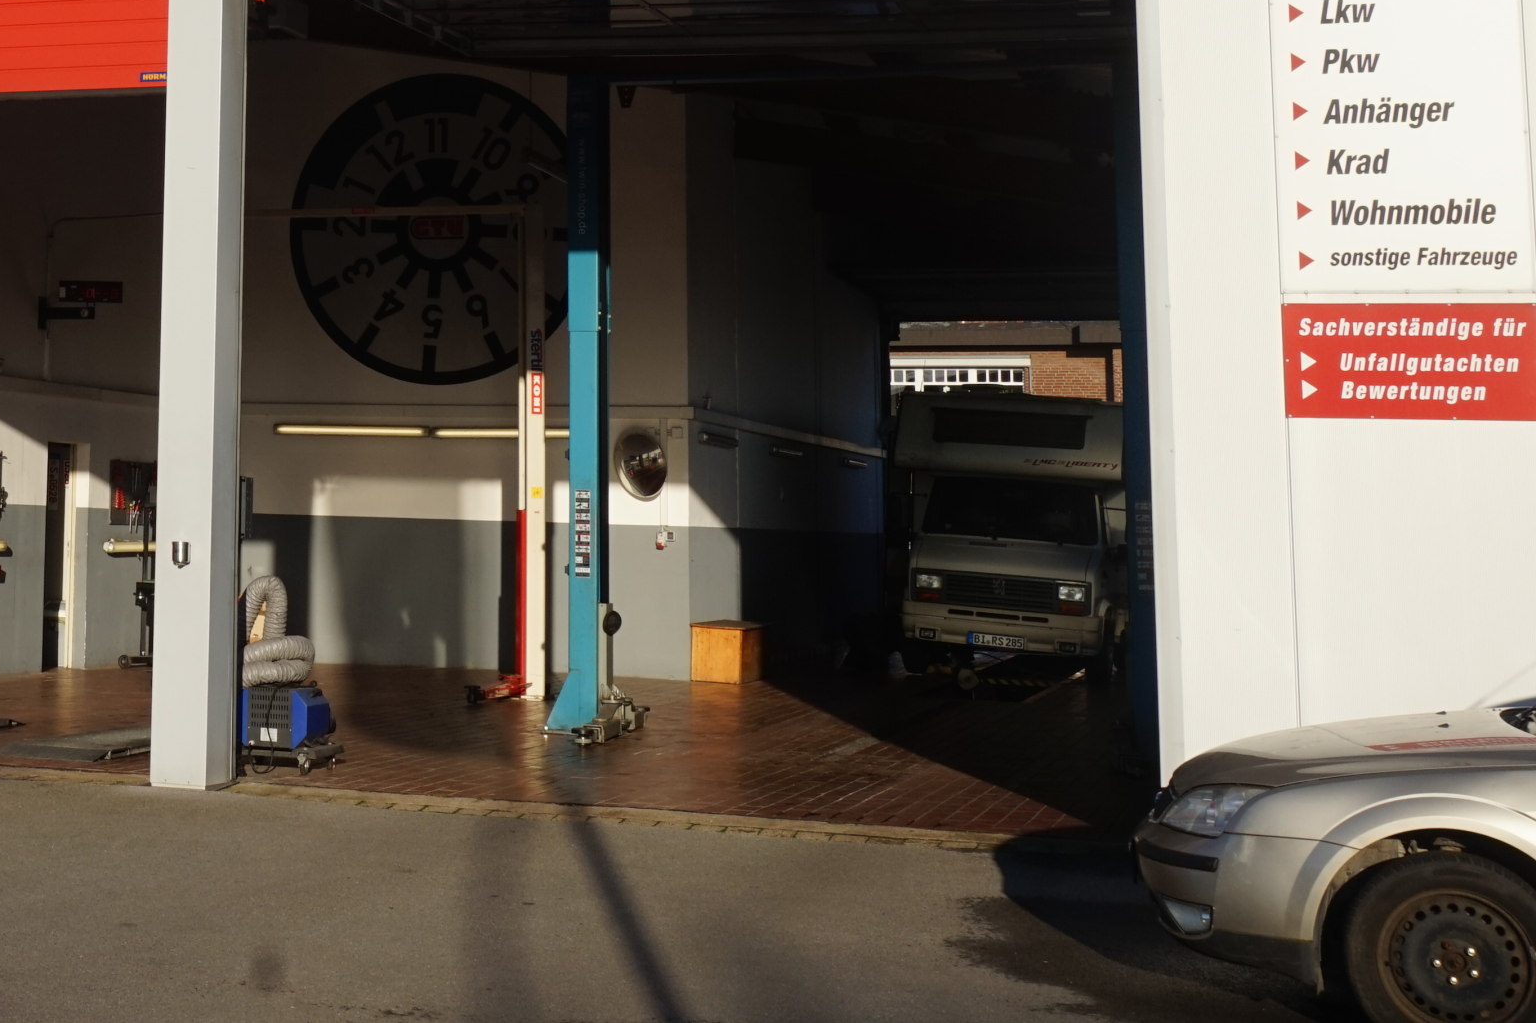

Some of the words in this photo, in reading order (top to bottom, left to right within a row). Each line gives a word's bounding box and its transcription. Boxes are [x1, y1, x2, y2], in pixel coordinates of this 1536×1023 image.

[1322, 48, 1380, 74] Pkw
[1323, 97, 1455, 129] Anhänger
[1326, 148, 1390, 175] Krad
[1330, 198, 1496, 226] Wohnmobile
[1330, 248, 1411, 270] sonstige
[1417, 247, 1518, 270] Fahrzeuge
[1299, 317, 1484, 340] Sachverständige
[1493, 318, 1527, 336] für
[1340, 353, 1519, 376] Unfallgutachten
[1341, 380, 1487, 404] Bewertungen
[974, 635, 985, 644] BI
[992, 636, 1004, 646] RS
[1006, 638, 1023, 648] 285
